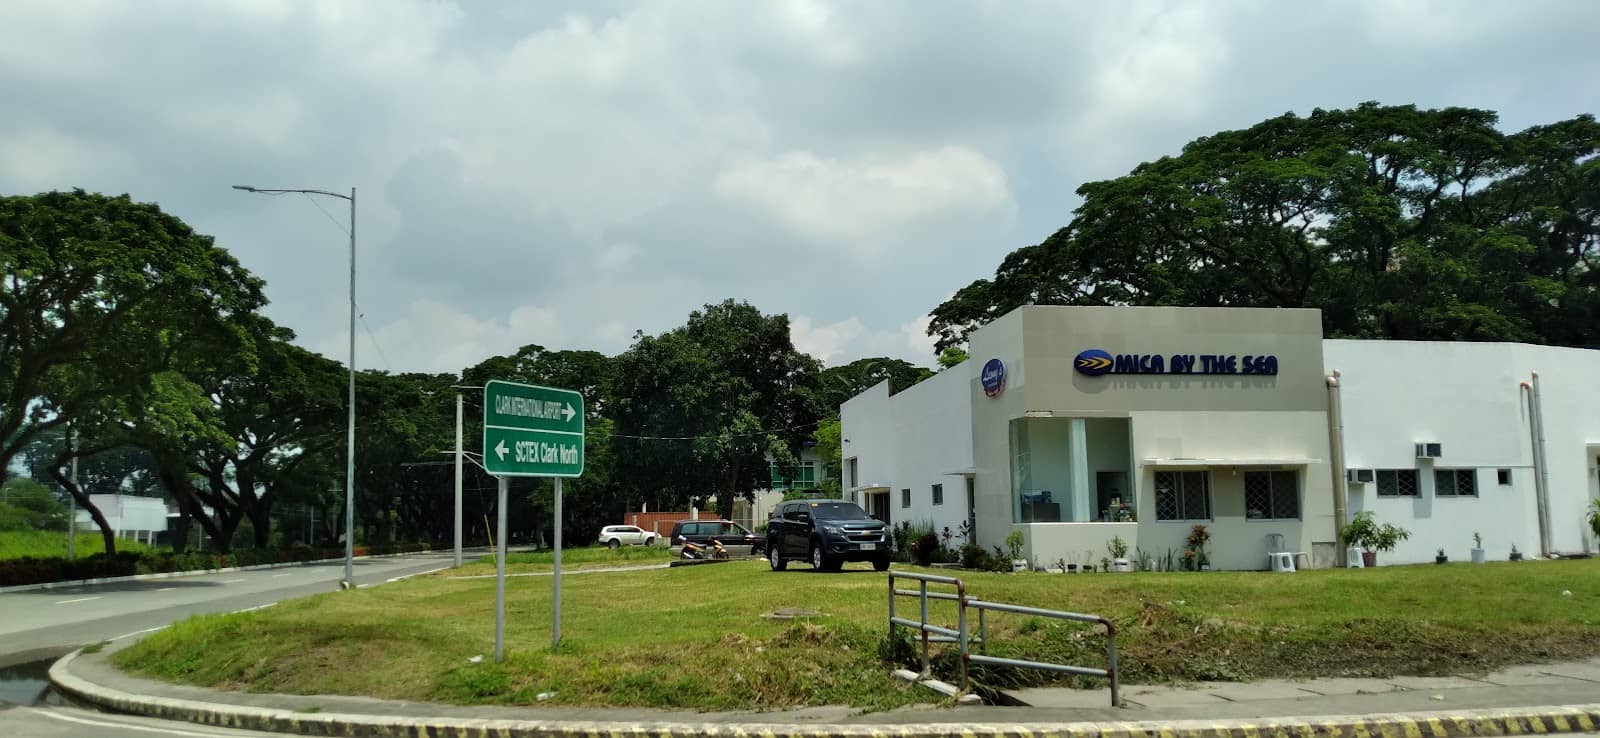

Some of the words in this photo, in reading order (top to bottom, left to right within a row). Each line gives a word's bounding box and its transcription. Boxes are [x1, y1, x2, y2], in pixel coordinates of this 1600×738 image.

[1115, 354, 1164, 374] MICA
[1170, 355, 1195, 374] BY
[1200, 355, 1237, 374] THE
[1242, 355, 1278, 375] SEA
[496, 395, 512, 415] CLARK
[512, 396, 543, 418] INTERNATIONAL
[544, 401, 561, 420] AIRPORT
[515, 440, 540, 463] SCTEX
[541, 442, 559, 464] Clark
[560, 444, 578, 465] North
